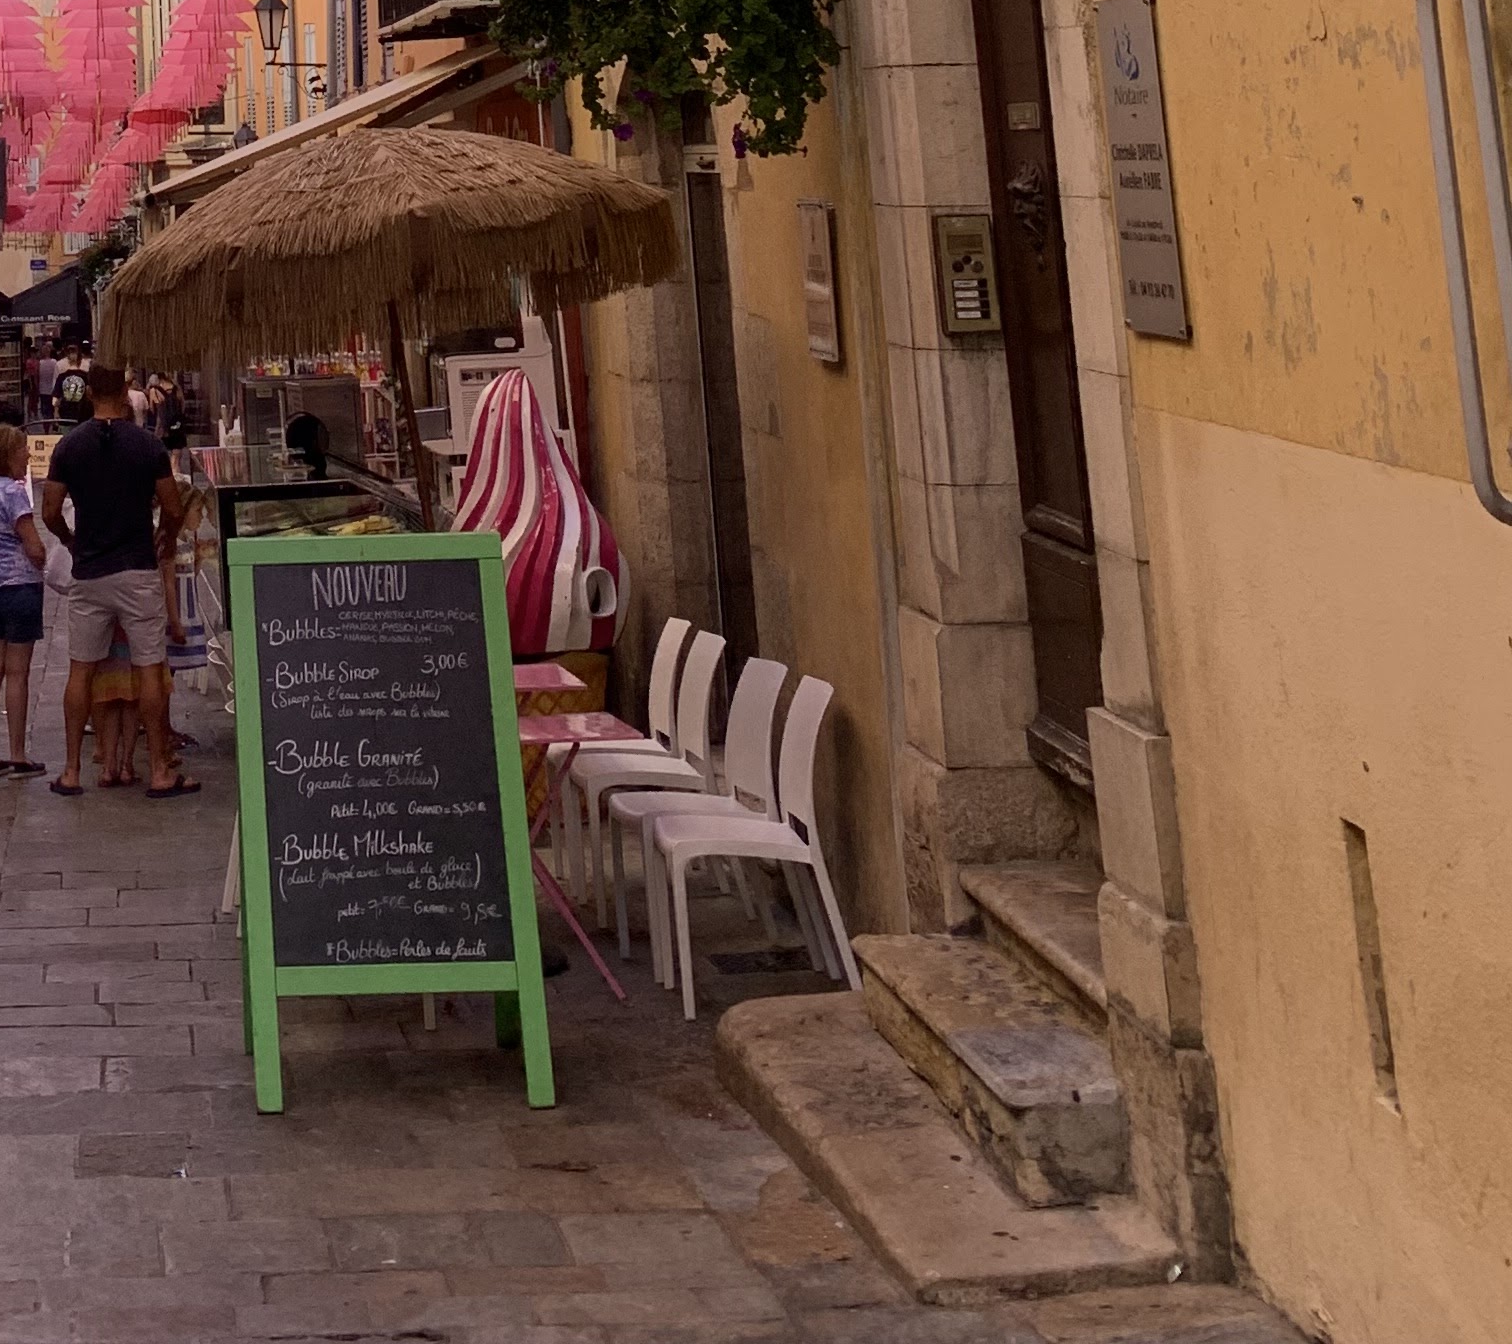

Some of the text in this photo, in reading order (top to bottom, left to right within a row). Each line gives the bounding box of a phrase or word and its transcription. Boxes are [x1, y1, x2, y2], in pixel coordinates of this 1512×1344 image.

[1113, 86, 1149, 106] Notaire
[48, 314, 71, 322] Rose
[312, 564, 407, 610] NOUVEAU
[420, 652, 471, 676] 3,00€
[362, 690, 387, 700] avec
[408, 875, 421, 890] et
[435, 940, 451, 956] de
